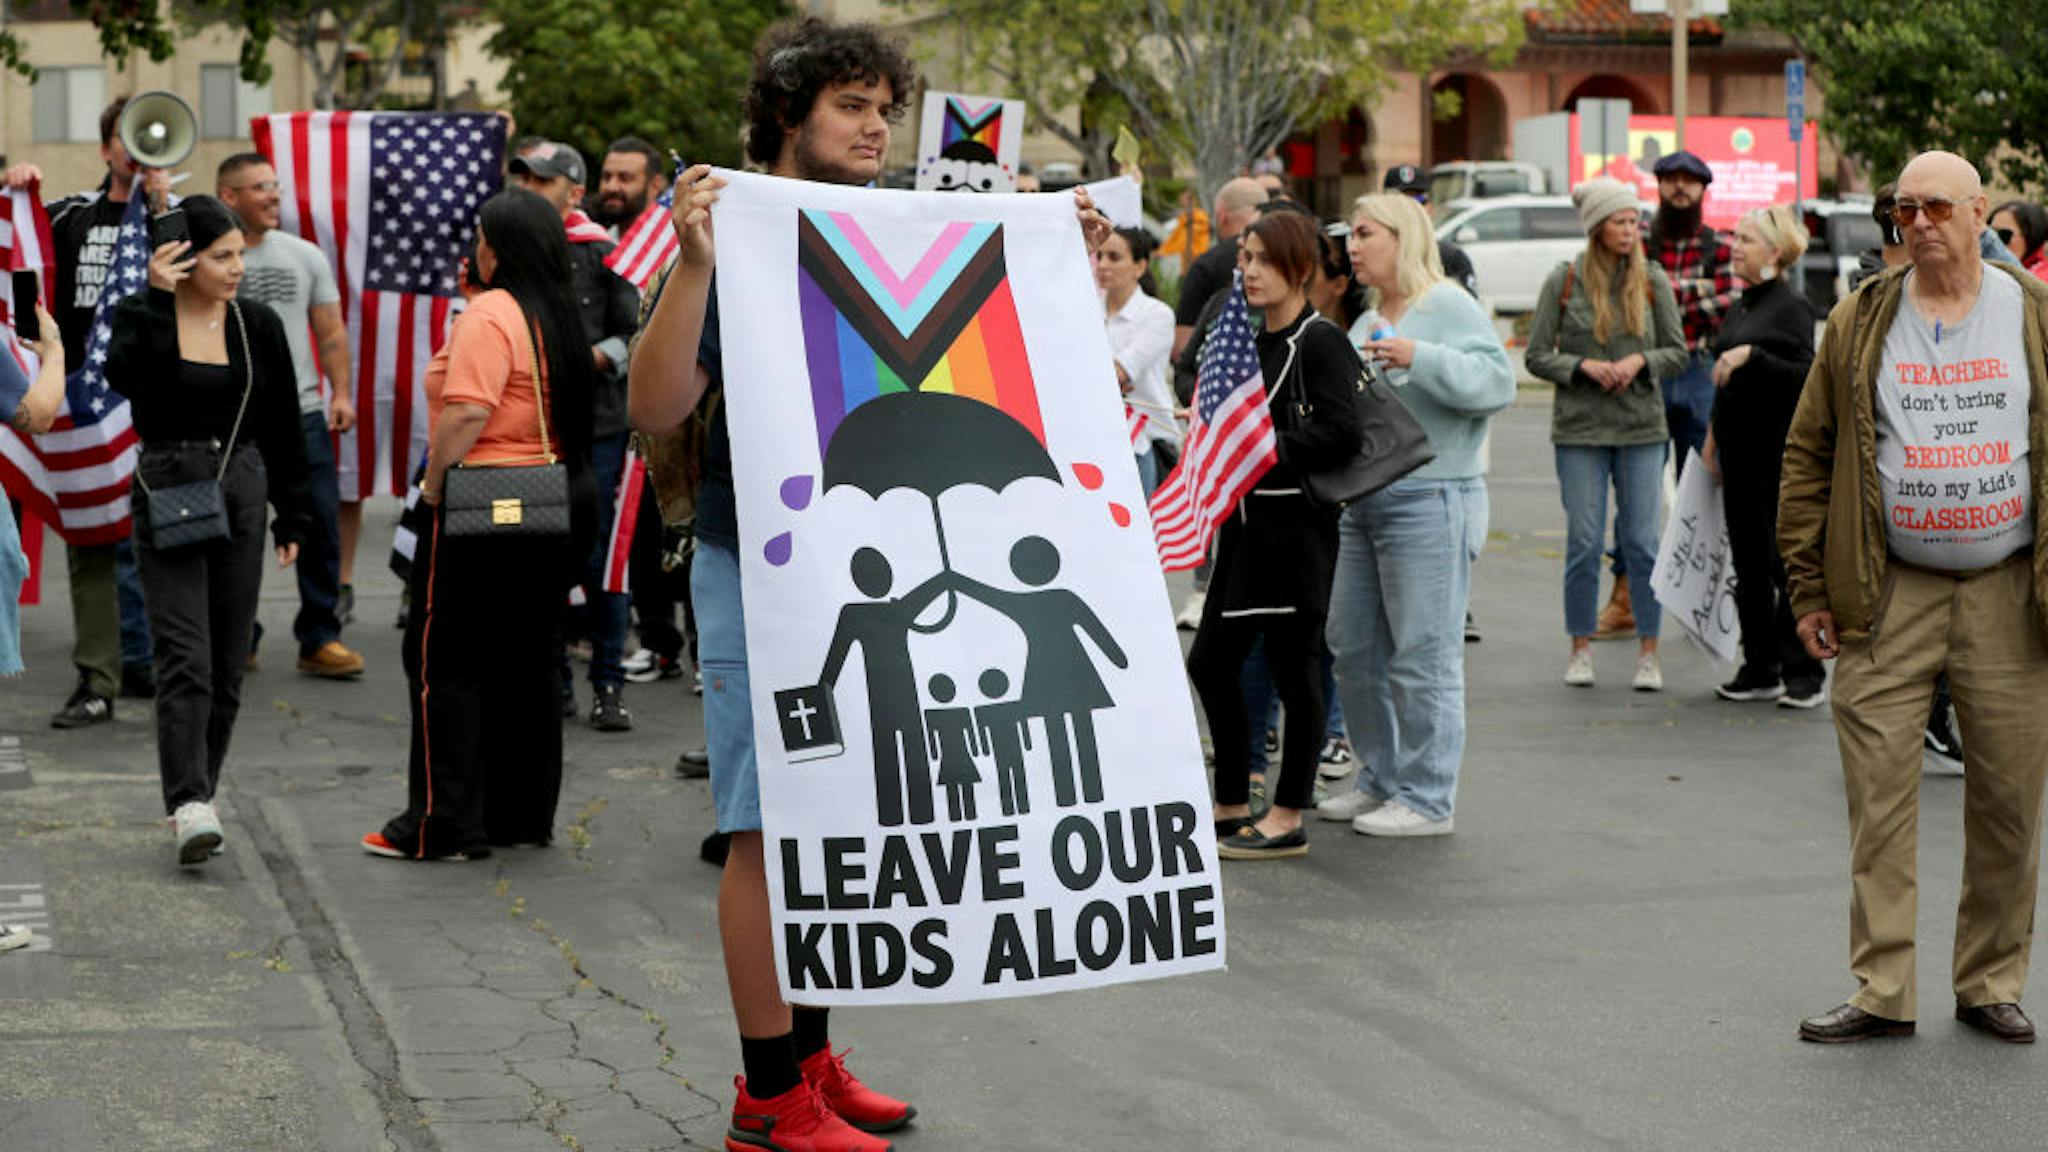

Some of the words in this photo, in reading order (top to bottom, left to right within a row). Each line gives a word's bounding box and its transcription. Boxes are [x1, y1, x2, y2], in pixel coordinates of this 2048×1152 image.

[1897, 359, 2008, 385] TEACHER:
[1901, 393, 1949, 411] don't
[1956, 392, 2007, 410] bring
[1934, 420, 1978, 440] your
[1904, 441, 2011, 468] BEDROOM
[1898, 479, 1937, 498] into
[1945, 482, 1970, 500] my
[1978, 471, 2016, 496] kid's
[1892, 496, 2023, 530] CLASSROOM
[780, 825, 1024, 911] LEAVE
[1051, 801, 1204, 891] OUR
[784, 918, 955, 990] KIDS
[982, 884, 1217, 985] ALONE
